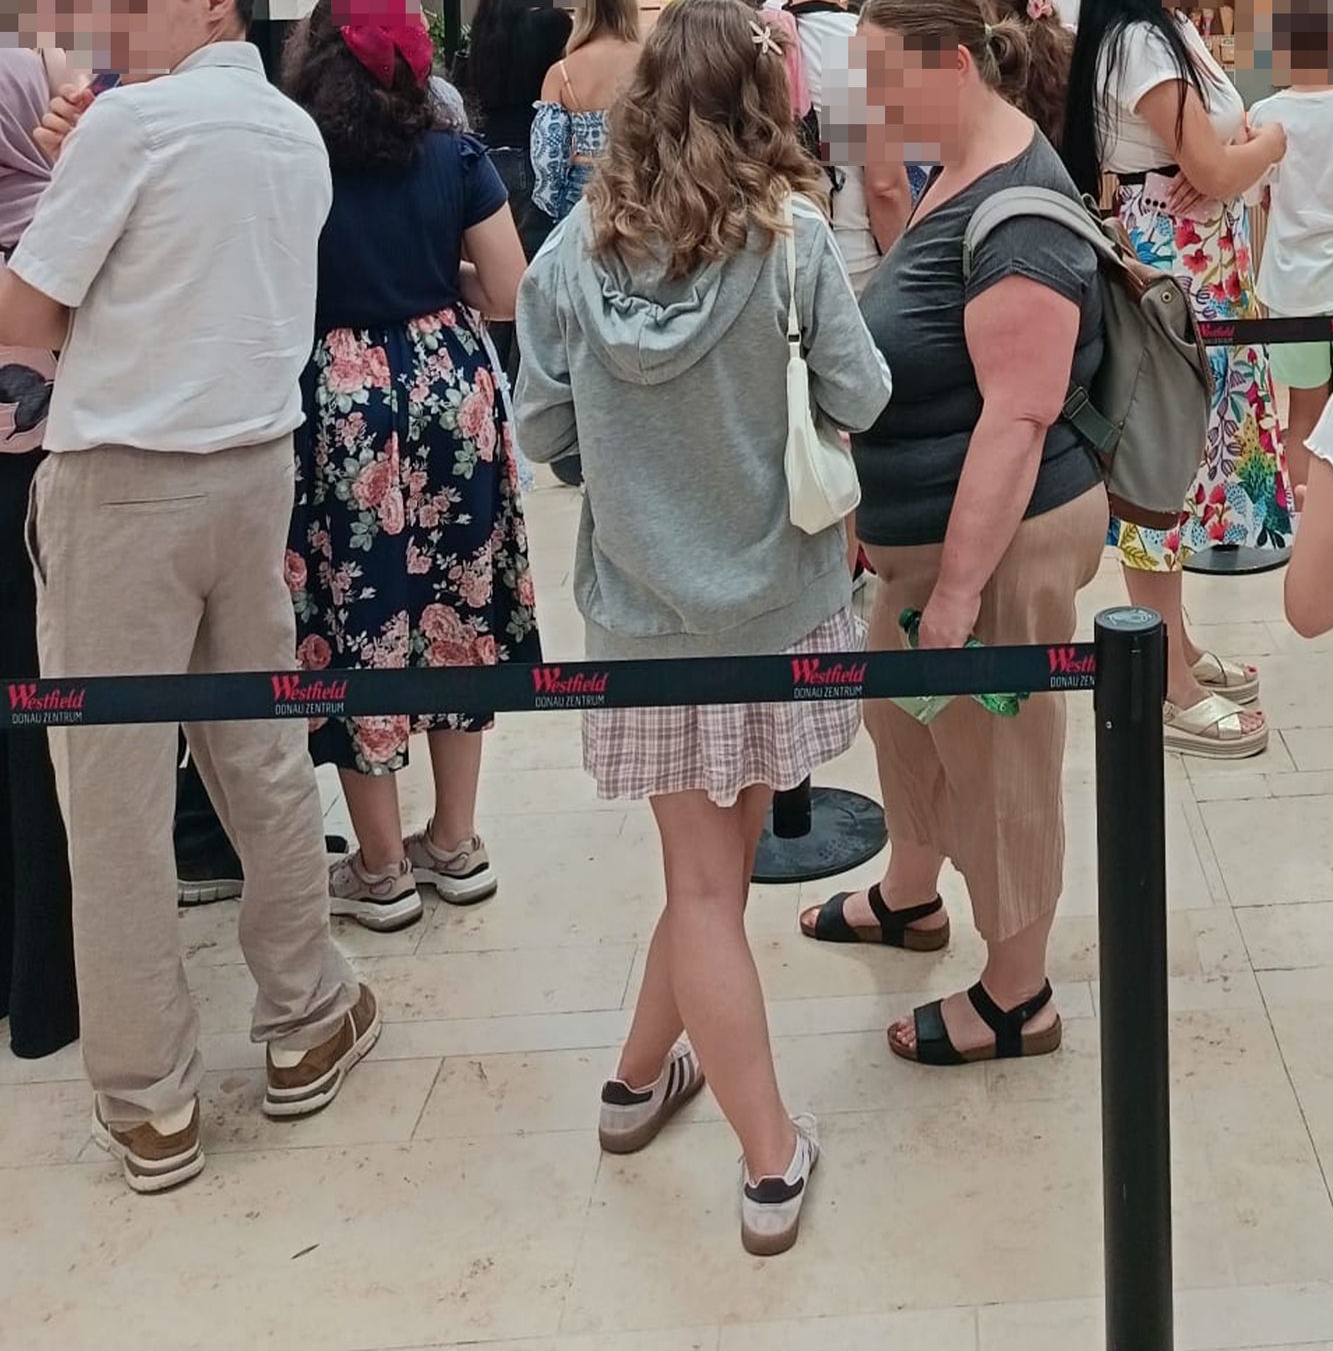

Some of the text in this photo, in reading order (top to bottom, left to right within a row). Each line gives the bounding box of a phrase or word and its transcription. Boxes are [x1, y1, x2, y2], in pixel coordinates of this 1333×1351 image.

[532, 666, 609, 695] Westfield
[791, 658, 867, 685] Westfield
[8, 681, 86, 710] Westfield
[271, 673, 348, 702] Westfield
[794, 685, 863, 699] DONAU ZENTRUM
[275, 702, 345, 715] DONAU ZENTRUM
[535, 694, 605, 708] DONAU ZENTRUM
[12, 711, 83, 725] DONAU ZENTRUM
